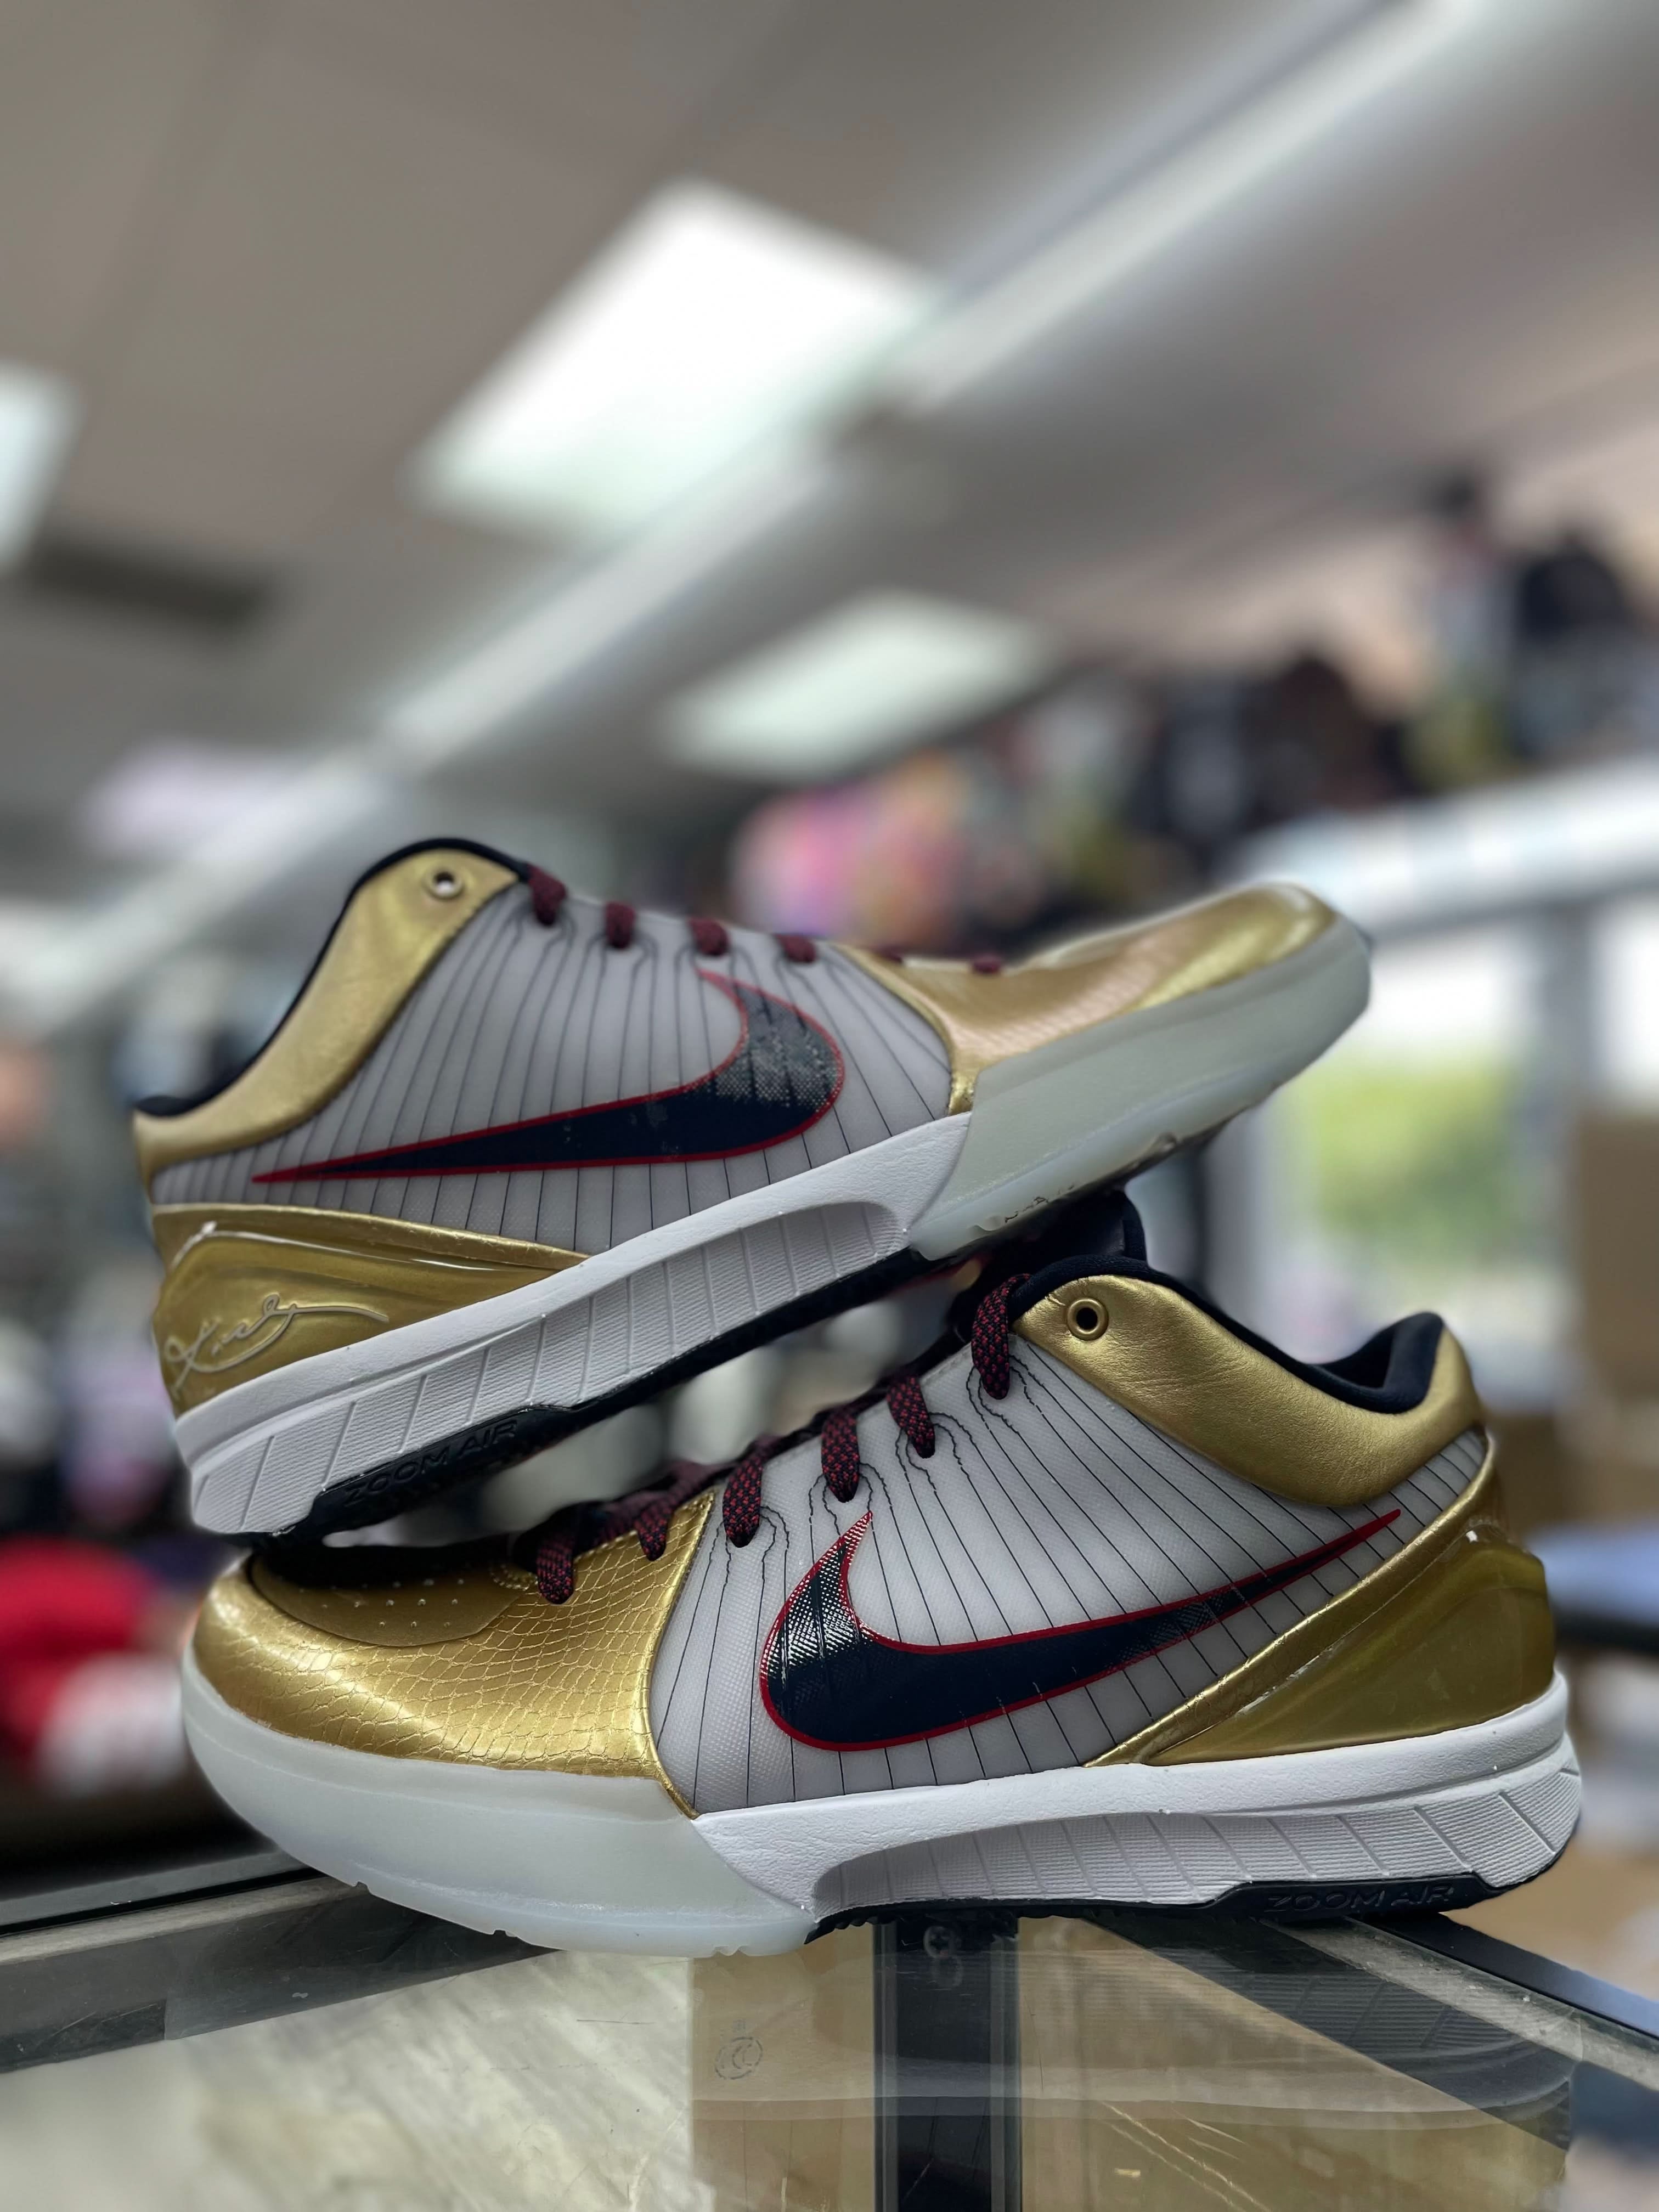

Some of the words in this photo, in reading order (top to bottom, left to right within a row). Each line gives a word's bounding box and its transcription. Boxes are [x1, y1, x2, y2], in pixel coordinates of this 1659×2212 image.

[344, 1446, 449, 1506] ZOOM
[458, 1420, 518, 1458] AIR
[1264, 1889, 1385, 1912] ZOOM
[1391, 1884, 1455, 1906] AIR
